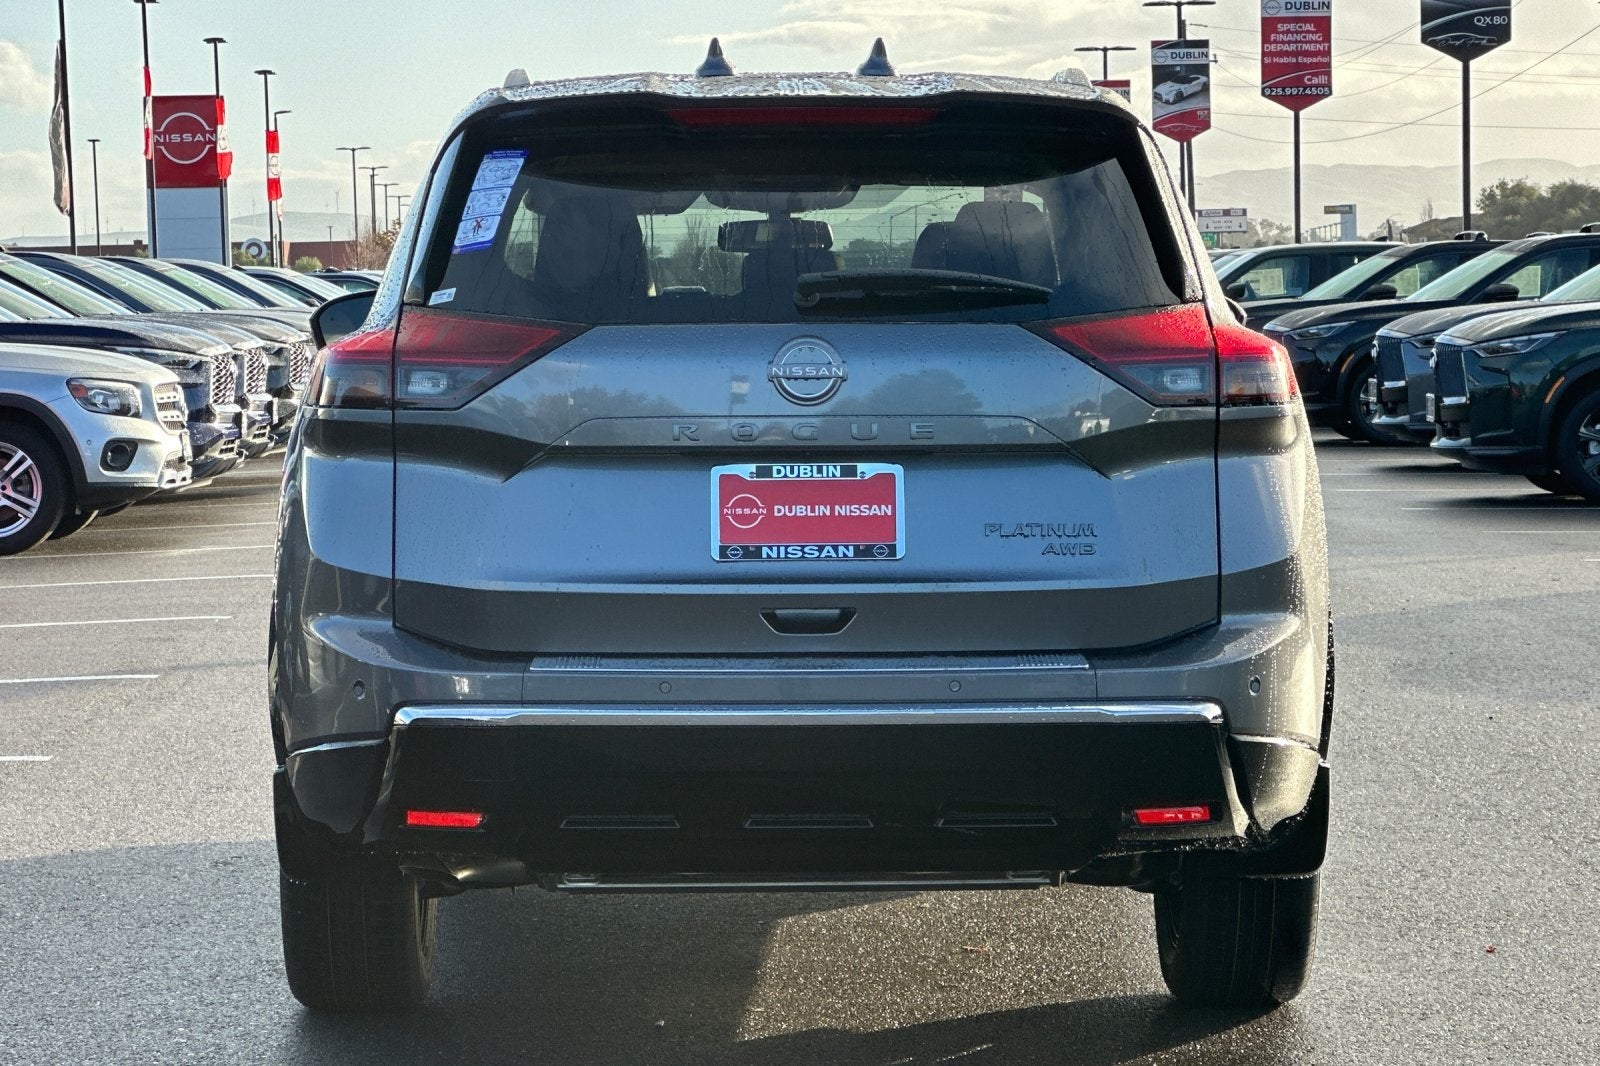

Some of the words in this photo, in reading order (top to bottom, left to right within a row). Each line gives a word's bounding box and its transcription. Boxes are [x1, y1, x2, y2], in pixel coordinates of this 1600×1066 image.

[1285, 2, 1330, 10] DUBLIN
[1474, 16, 1508, 26] QX80
[1170, 51, 1208, 60] DUBLIN
[1298, 56, 1330, 64] Español
[1304, 75, 1328, 85] Call!
[1264, 87, 1330, 96] 925.997.4505
[153, 133, 216, 143] NISSAN
[772, 366, 843, 376] NISSAN
[672, 422, 935, 442] ROGUE
[772, 465, 841, 478] DUBLIN
[773, 505, 830, 517] DUBLIN
[834, 504, 892, 516] NISSAN
[984, 522, 1098, 538] PLATINUM
[761, 545, 854, 559] NISSAN
[1041, 542, 1097, 556] AWD
